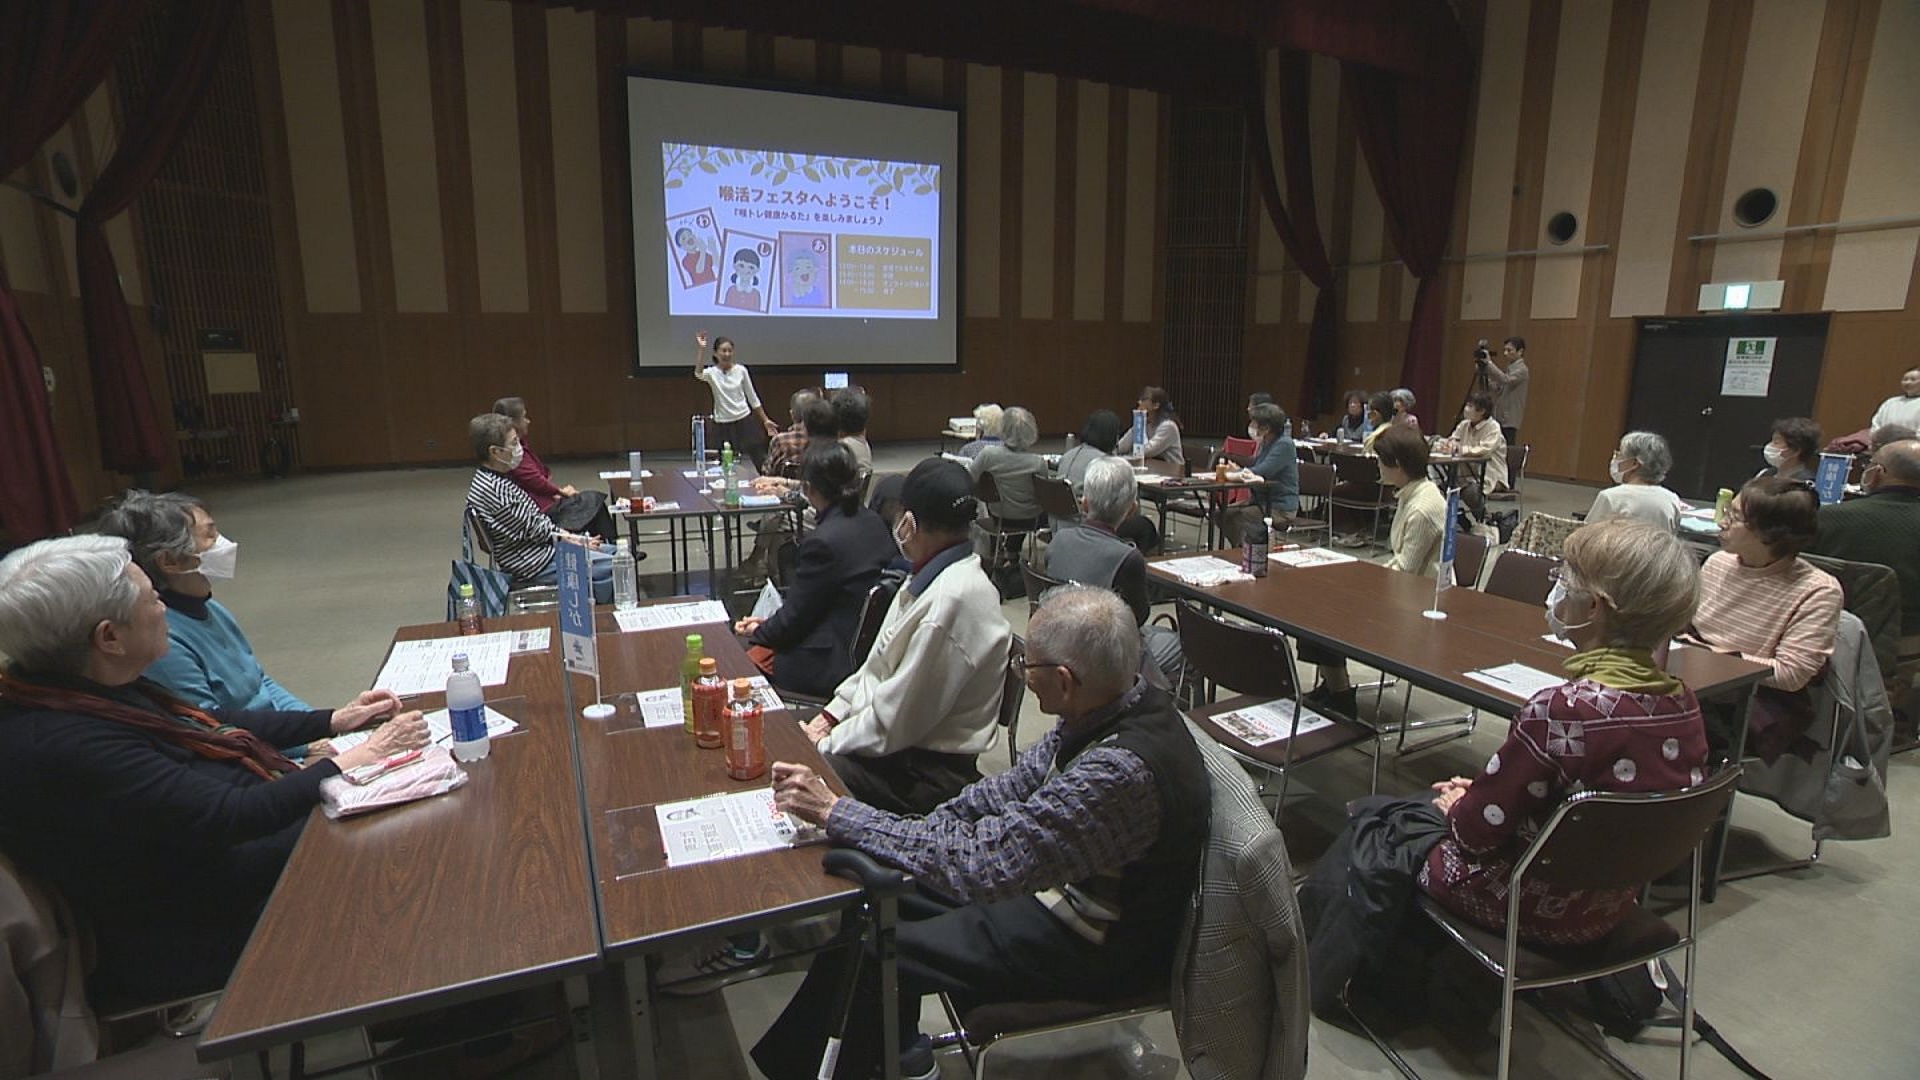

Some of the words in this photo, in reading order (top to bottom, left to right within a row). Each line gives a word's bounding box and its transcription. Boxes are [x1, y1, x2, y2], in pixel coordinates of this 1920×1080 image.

[848, 244, 924, 257] 本日のスケジュール
